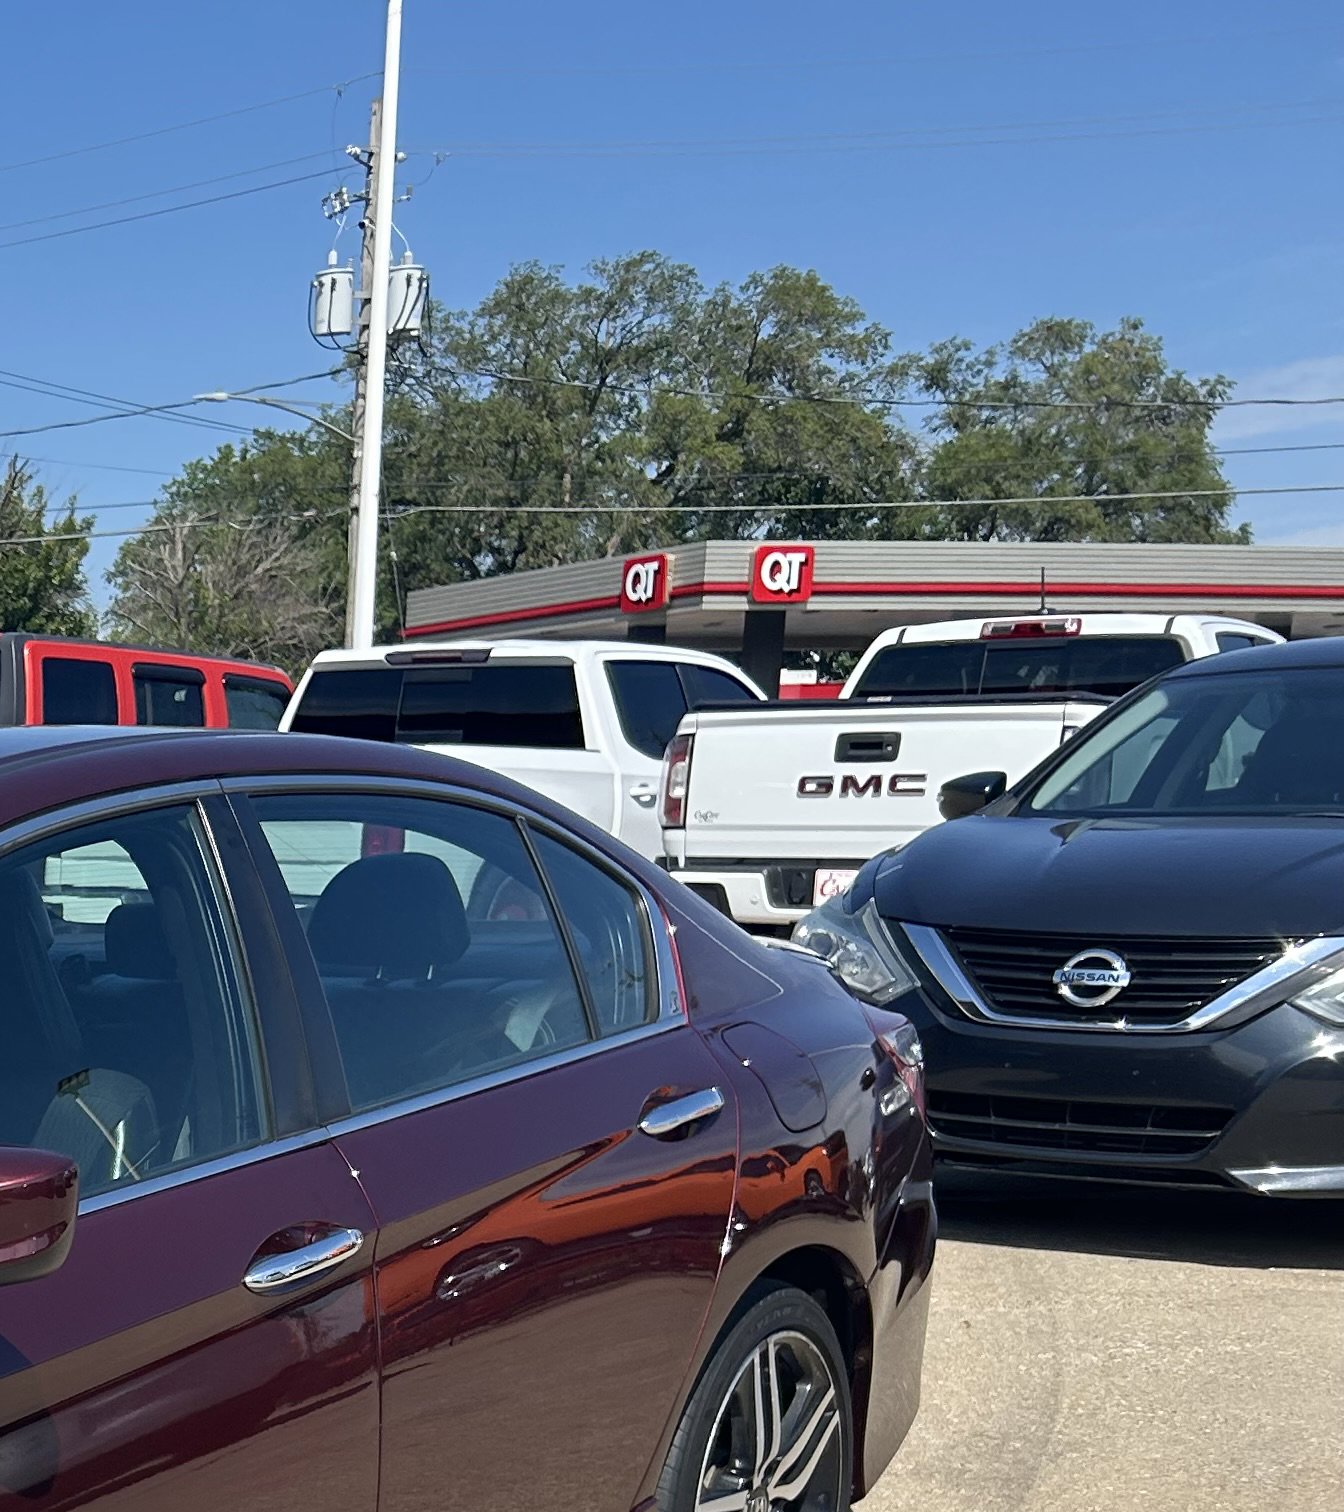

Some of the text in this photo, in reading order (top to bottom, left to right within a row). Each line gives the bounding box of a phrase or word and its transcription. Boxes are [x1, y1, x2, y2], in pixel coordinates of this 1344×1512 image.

[625, 561, 658, 603] QT
[760, 551, 805, 593] QT
[796, 773, 928, 799] GMC
[1059, 972, 1120, 983] NISSAN
